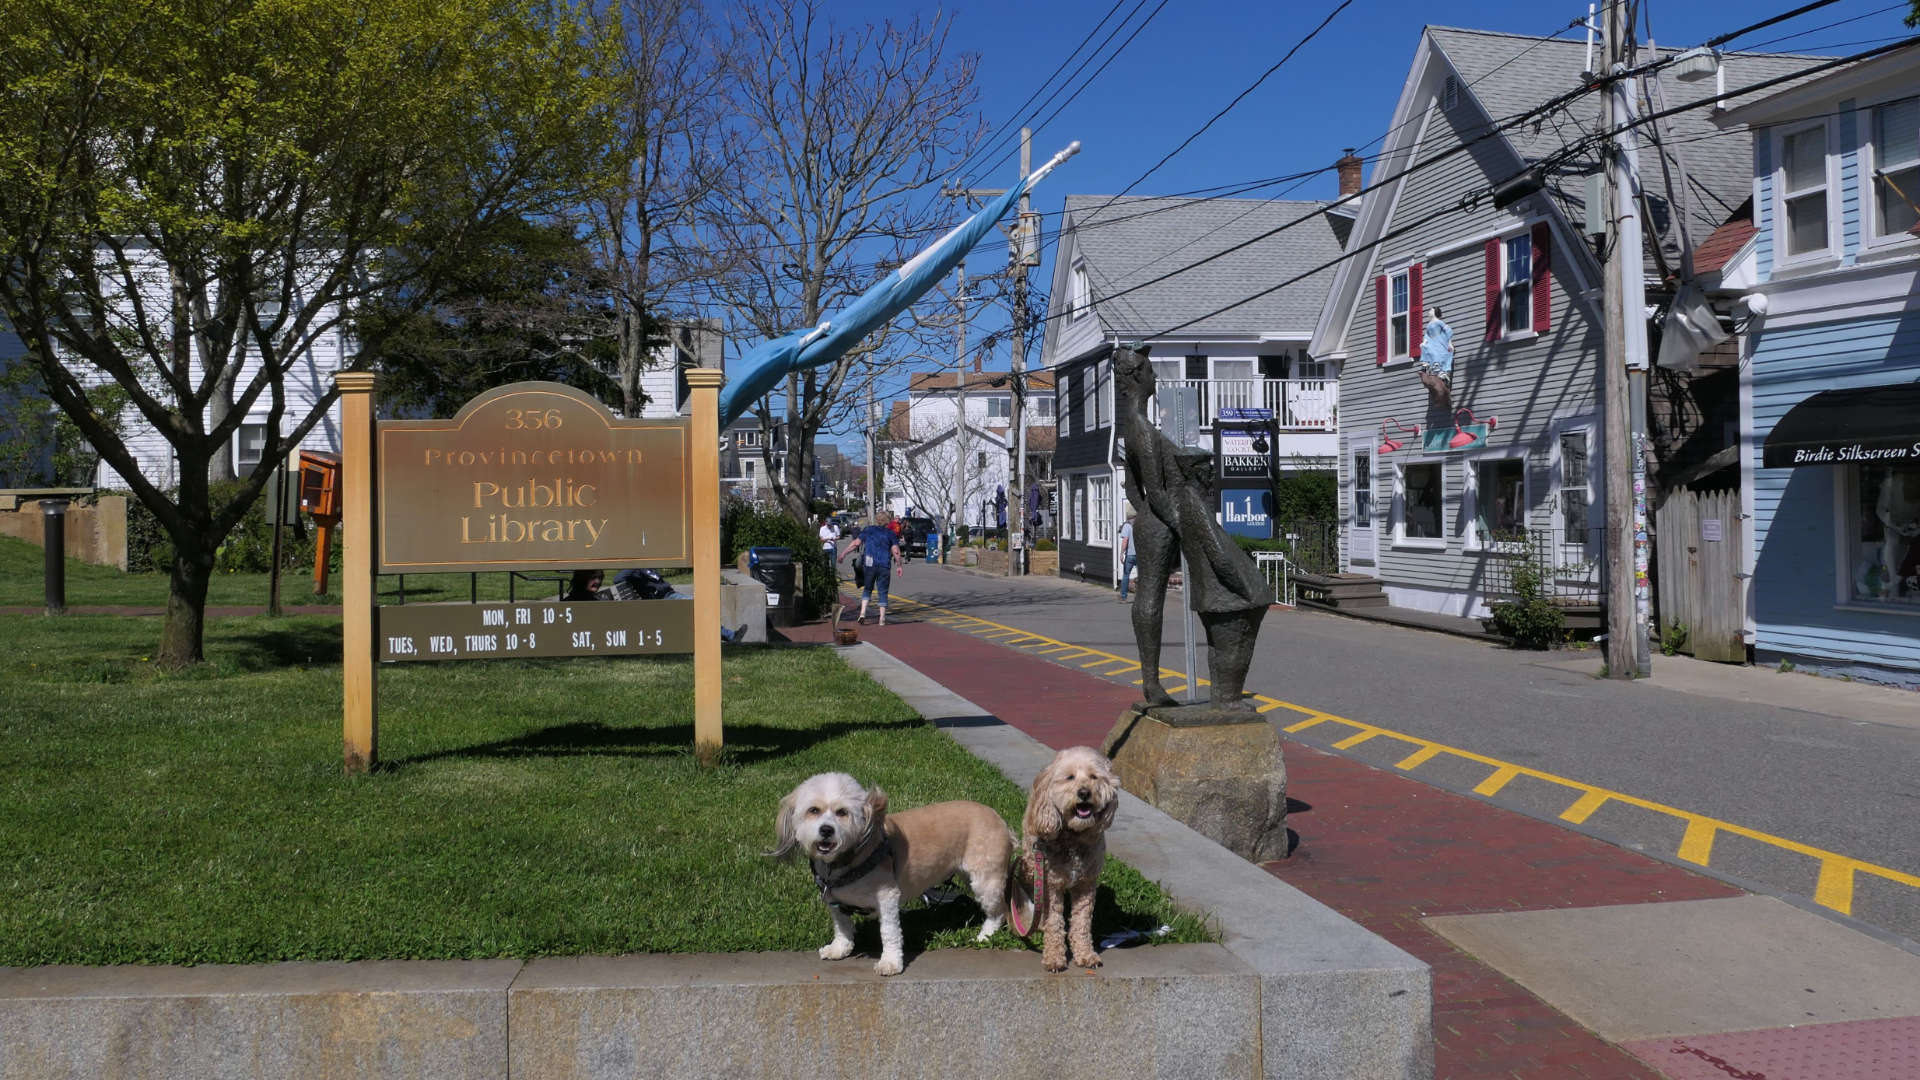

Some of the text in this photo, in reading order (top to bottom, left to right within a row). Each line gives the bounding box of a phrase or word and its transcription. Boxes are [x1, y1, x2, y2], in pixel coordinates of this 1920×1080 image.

[504, 408, 563, 430] 356
[424, 448, 644, 466] Provincetown
[1794, 446, 1834, 463] Birdie
[1837, 444, 1907, 461] Silkscreen
[472, 478, 598, 509] Public
[1225, 496, 1268, 522] Harbor
[460, 513, 608, 548] Library
[483, 610, 509, 628] MON,
[515, 608, 531, 624] FRI
[388, 636, 418, 656] TUES,
[430, 635, 458, 656] WED,
[465, 634, 497, 652] THURS
[572, 630, 595, 651] SAT,
[606, 630, 626, 647] SUN
